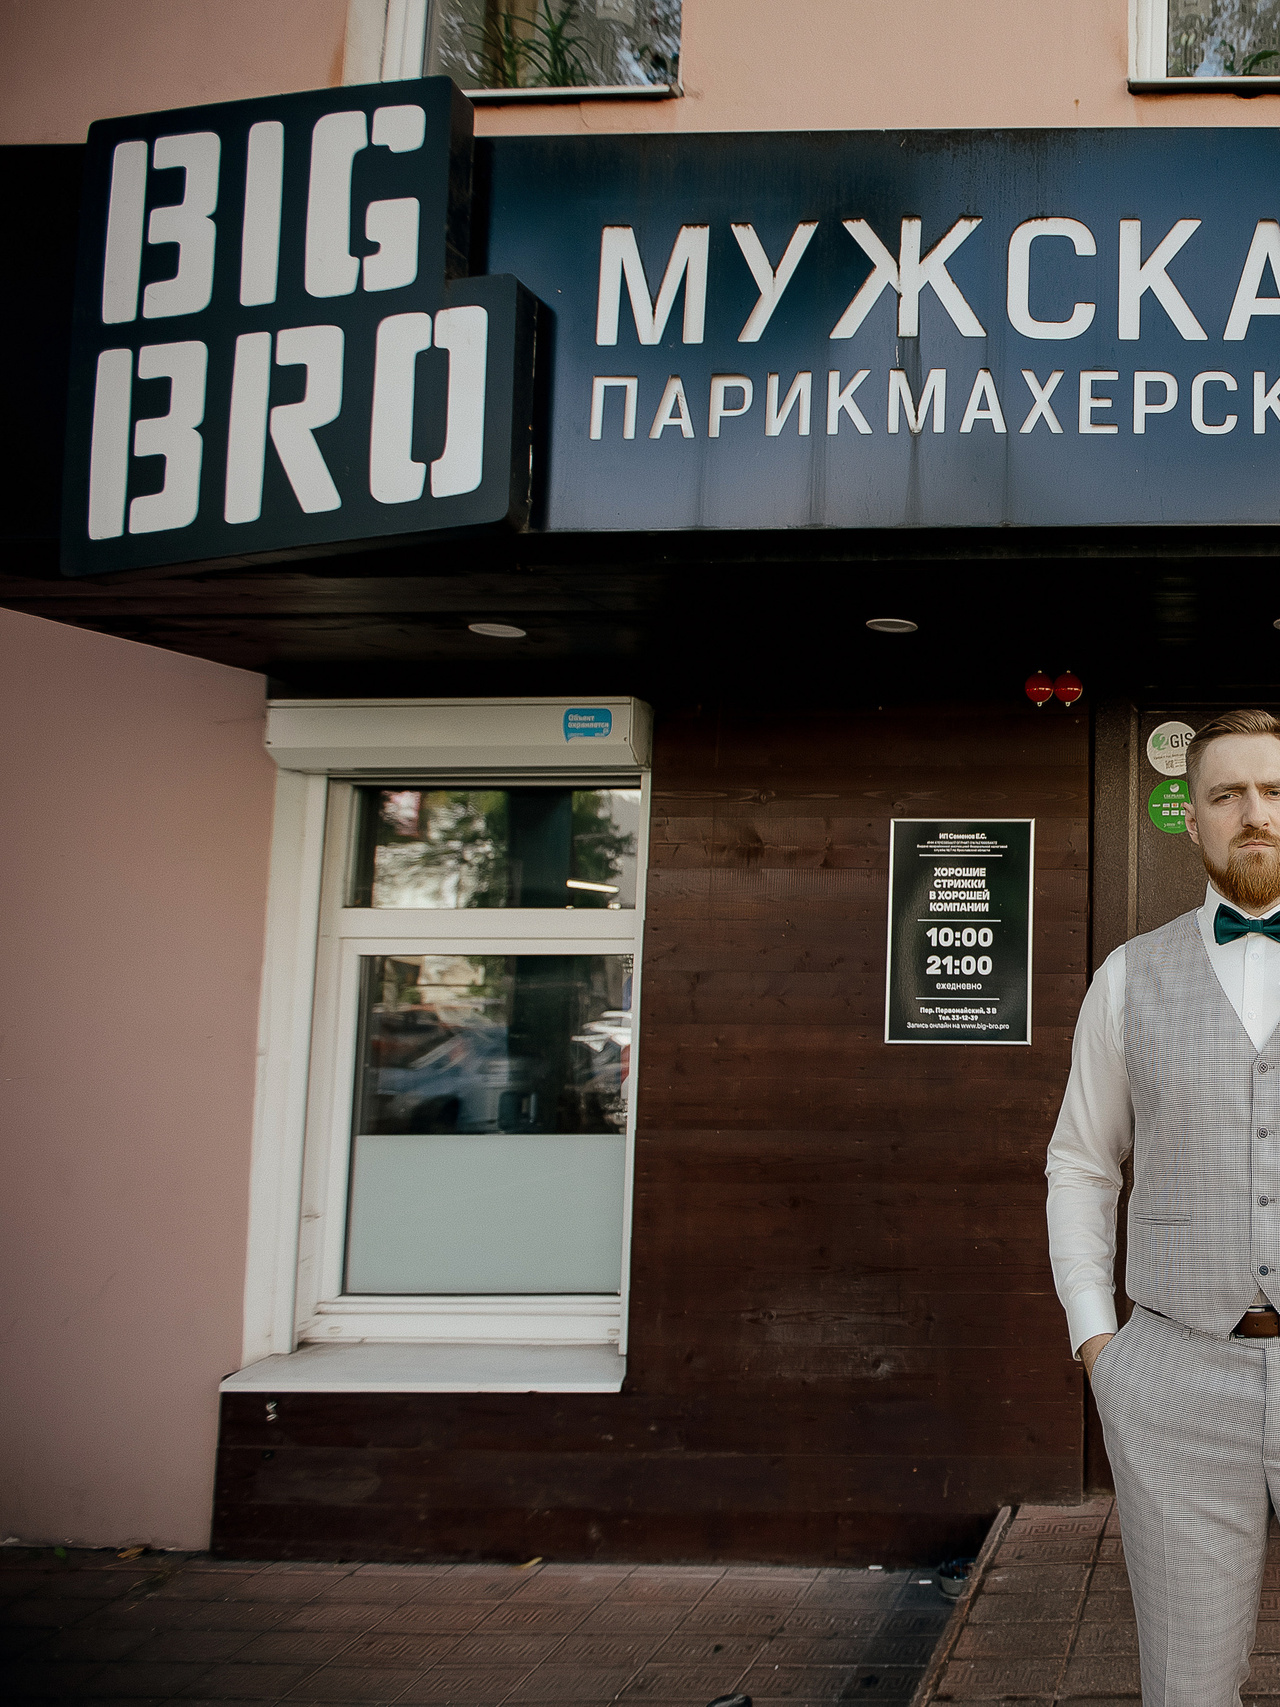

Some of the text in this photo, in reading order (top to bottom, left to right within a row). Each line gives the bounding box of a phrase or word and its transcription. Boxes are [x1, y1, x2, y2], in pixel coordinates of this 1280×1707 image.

[101, 104, 427, 325] BIG
[88, 304, 488, 541] BRO
[933, 867, 986, 877] ХОРОШИЕ
[933, 878, 986, 889] СТРИЖКИ
[929, 889, 990, 901] В ХОРОШЕЙ
[929, 902, 989, 912] КОМПАНИИ
[925, 927, 994, 948] 10:00
[925, 955, 993, 975] 21:00
[936, 982, 982, 991] ежедневно
[919, 1006, 935, 1014] Пер.
[906, 1021, 929, 1029] Запись
[929, 1021, 952, 1029] онлайн
[961, 1022, 1010, 1031] www.big-bro.pro
